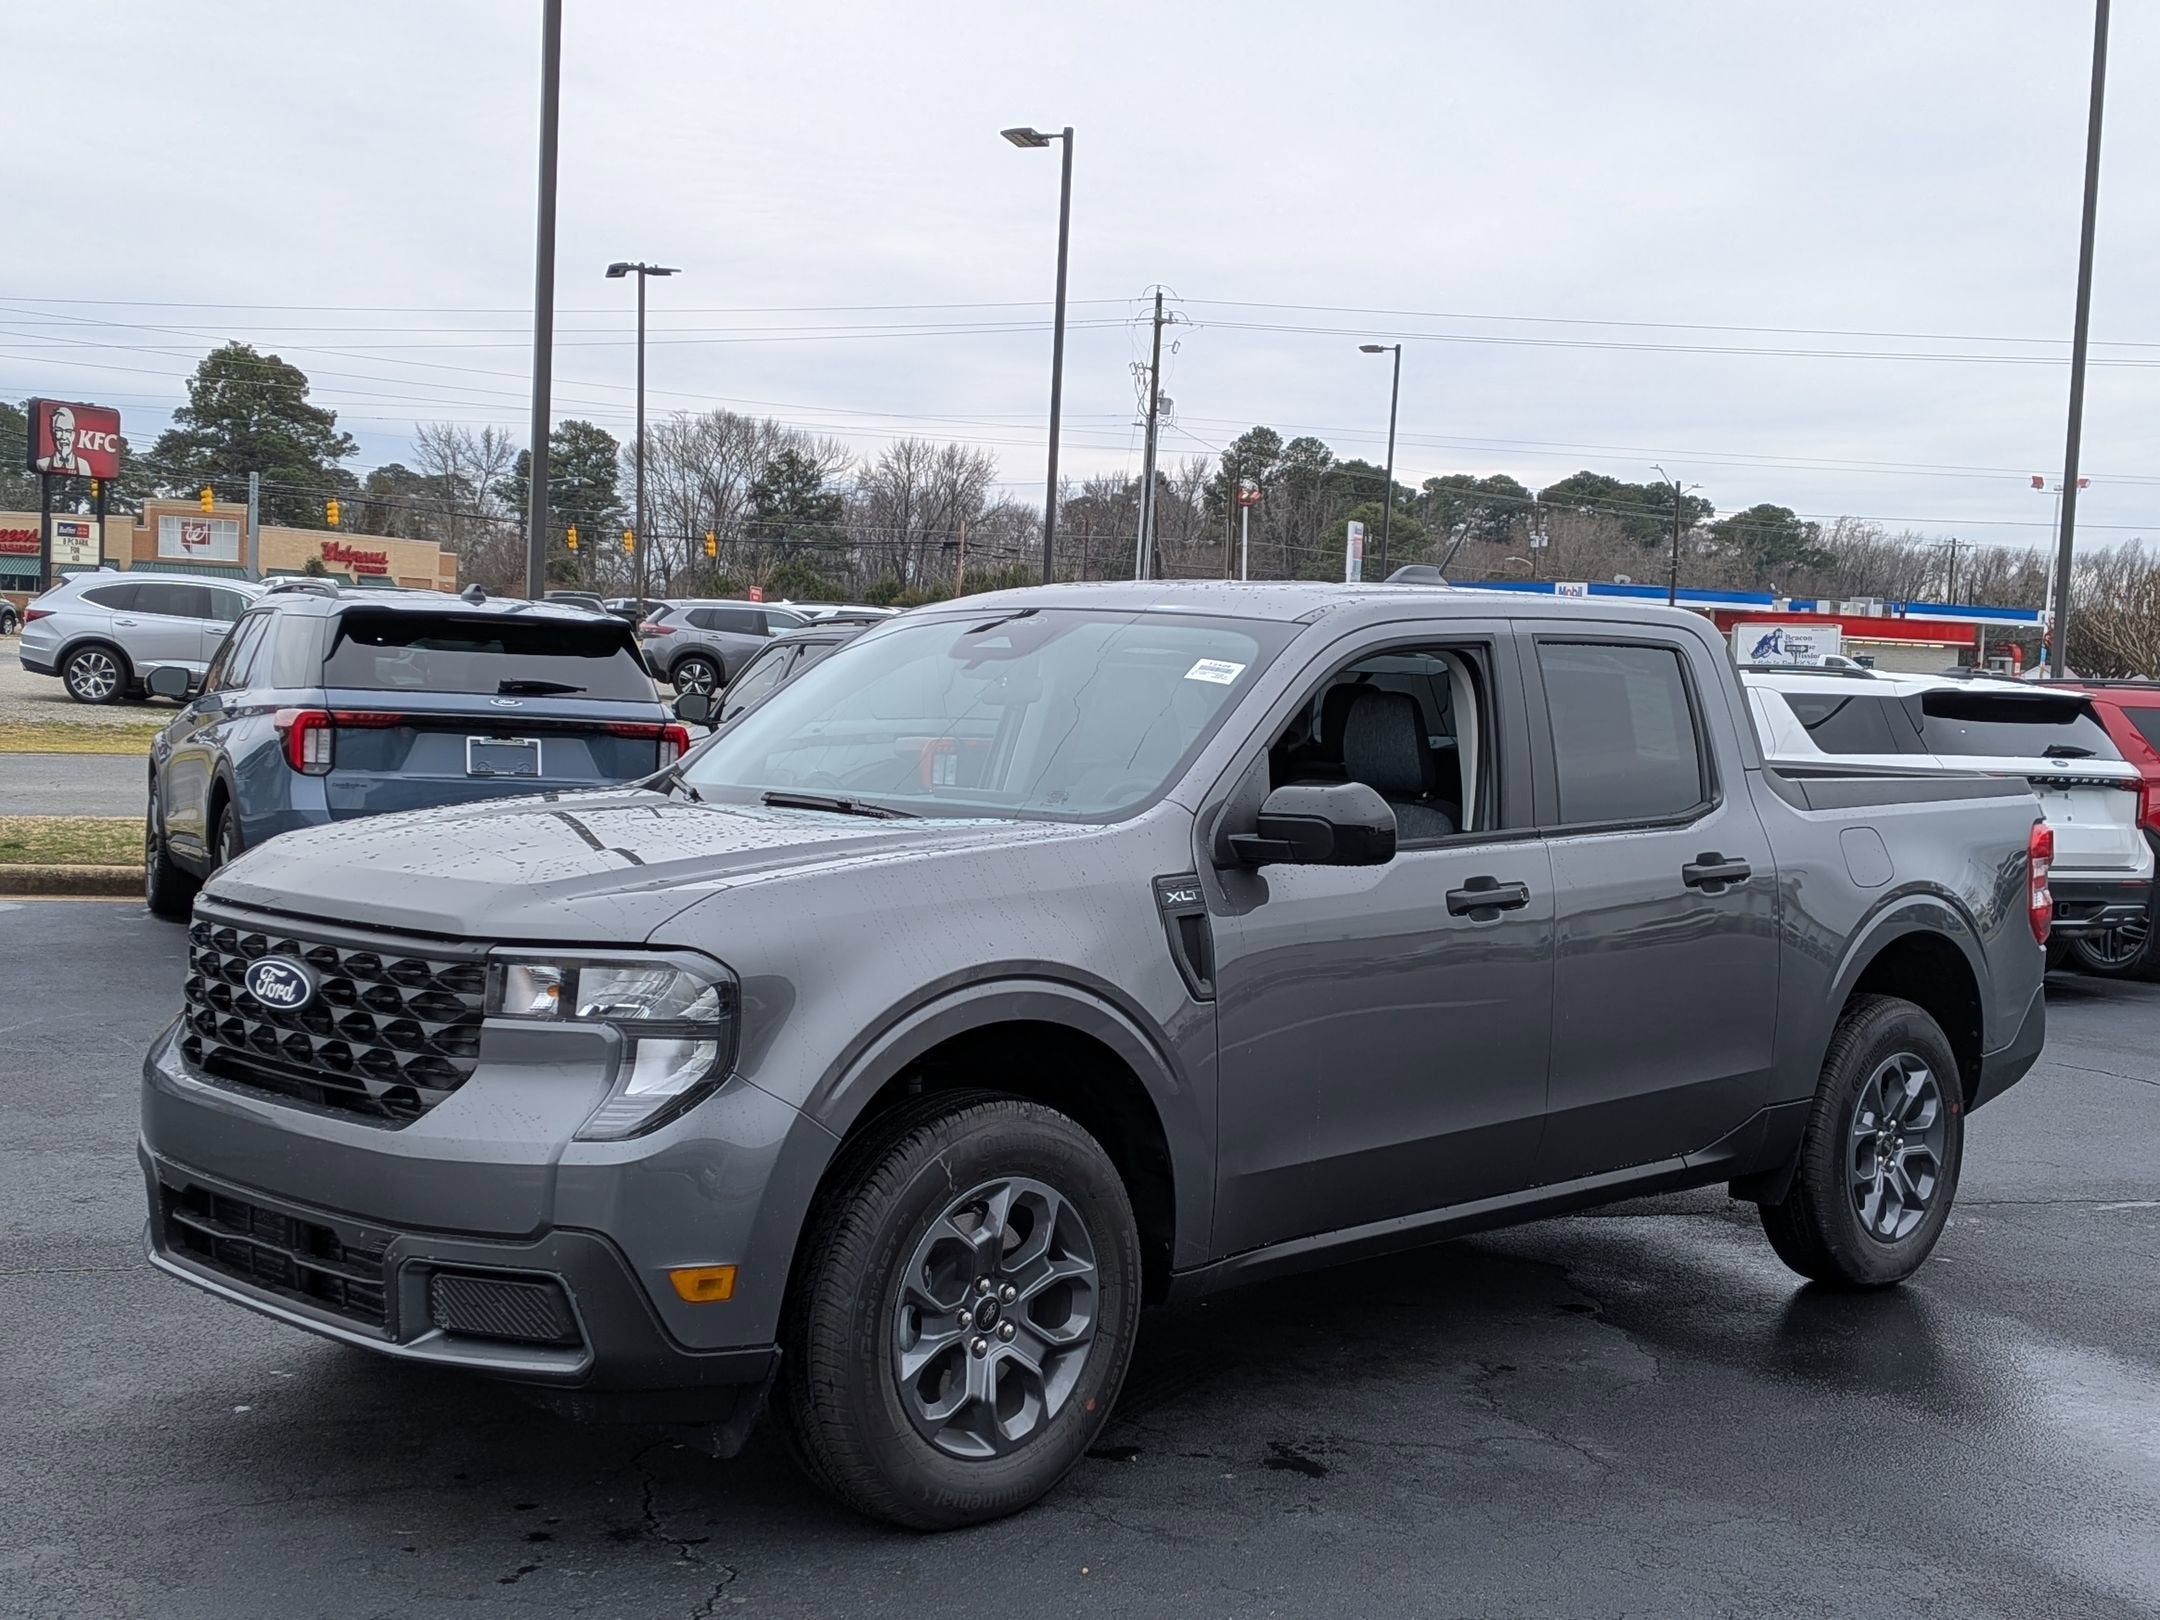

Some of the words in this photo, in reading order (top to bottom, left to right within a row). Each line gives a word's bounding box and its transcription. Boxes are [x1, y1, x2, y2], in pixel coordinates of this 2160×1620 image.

[77, 429, 118, 453] KFC
[1558, 585, 1583, 598] Mobil
[1785, 634, 1813, 642] Beacon
[2033, 776, 2110, 784] XPLORER
[1166, 889, 1201, 903] XLT
[255, 965, 298, 1002] Ford
